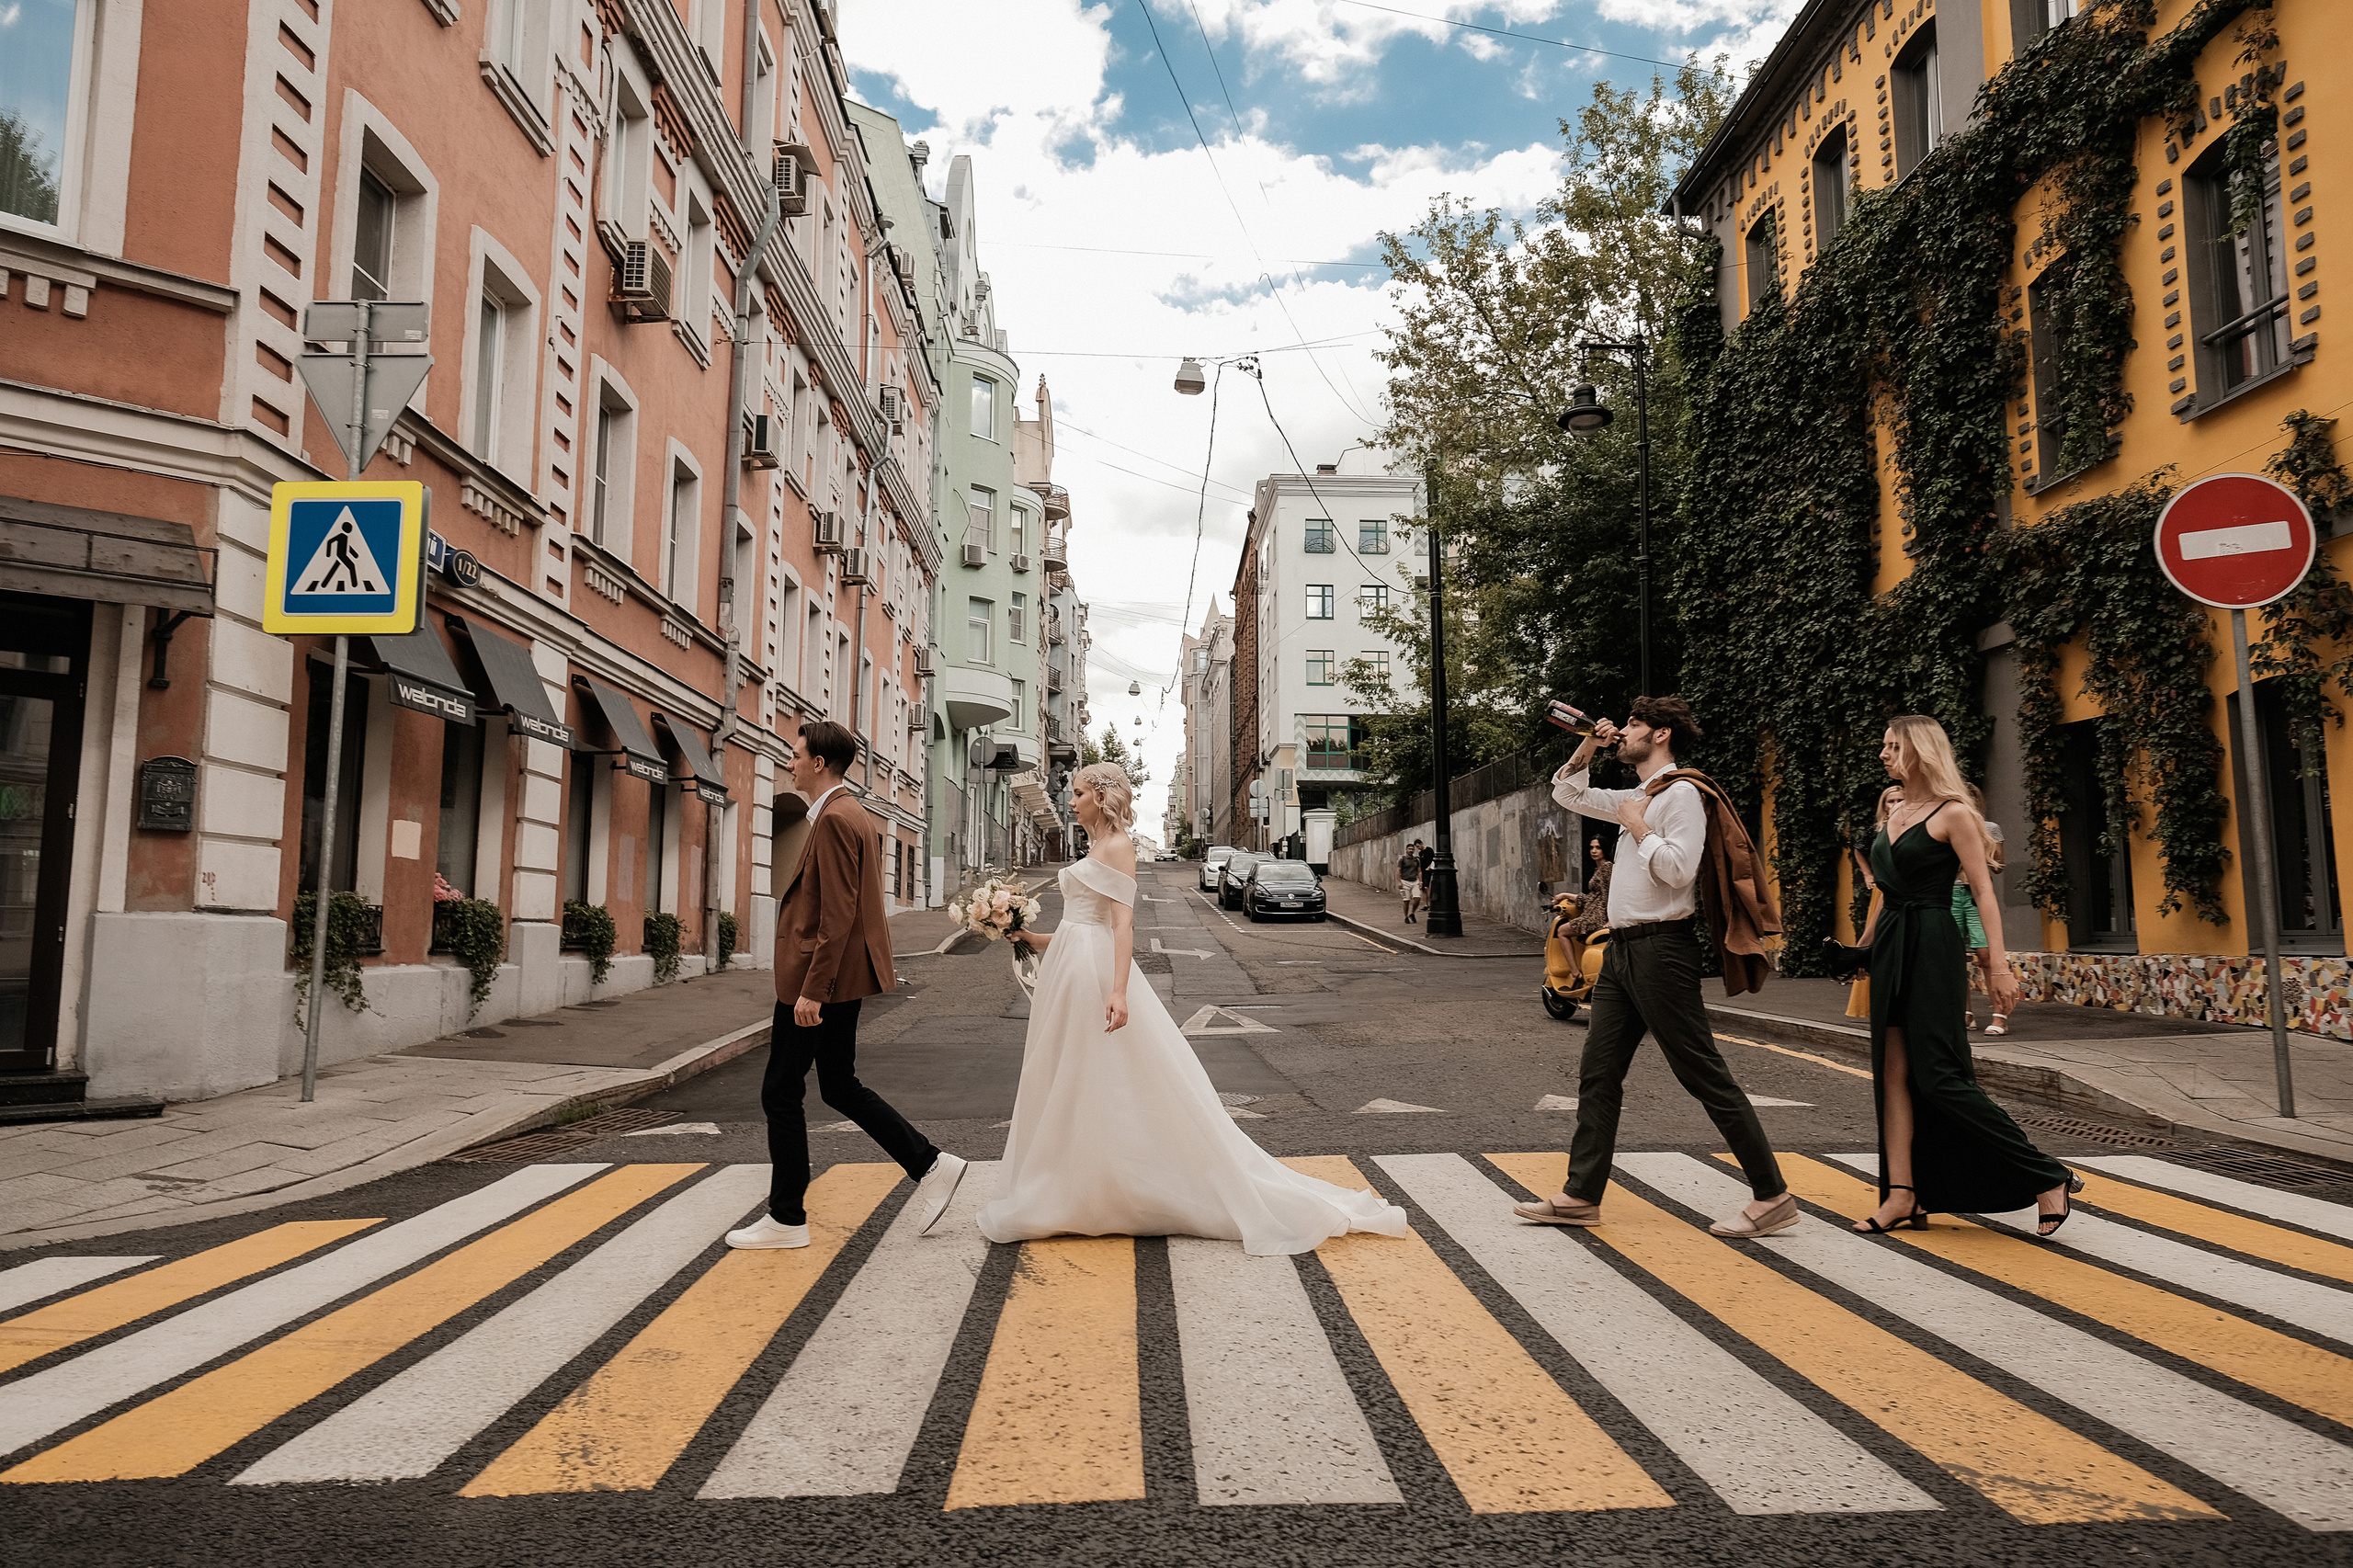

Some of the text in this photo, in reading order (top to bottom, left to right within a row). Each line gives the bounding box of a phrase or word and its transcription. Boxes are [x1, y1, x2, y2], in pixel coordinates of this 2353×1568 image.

[458, 558, 477, 580] 1/22
[398, 683, 467, 718] welonda
[520, 714, 570, 743] welonda
